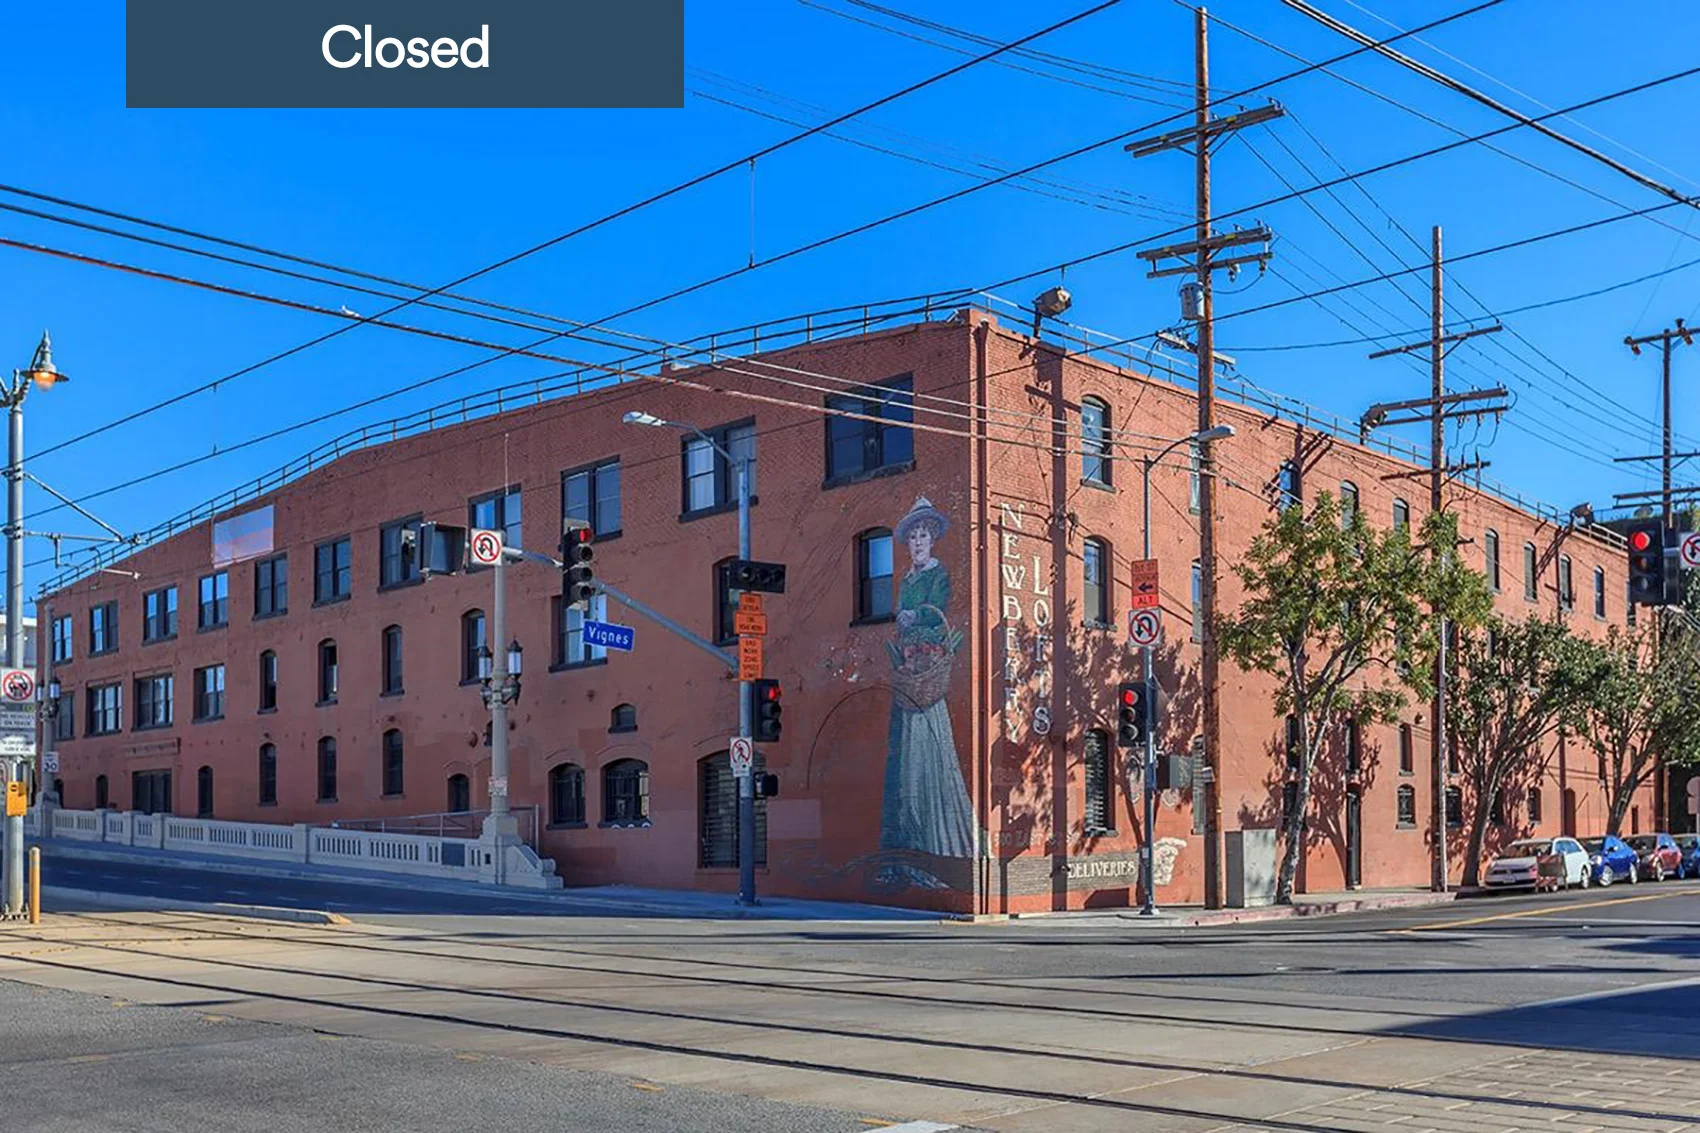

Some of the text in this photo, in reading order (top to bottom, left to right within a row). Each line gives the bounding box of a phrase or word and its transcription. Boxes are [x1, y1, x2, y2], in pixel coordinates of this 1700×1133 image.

[1000, 502, 1026, 744] NEWBERRY
[588, 626, 629, 645] Vignes
[1032, 553, 1051, 735] LOFTS
[44, 762, 57, 772] 30
[1067, 860, 1136, 879] DELIVERIES
